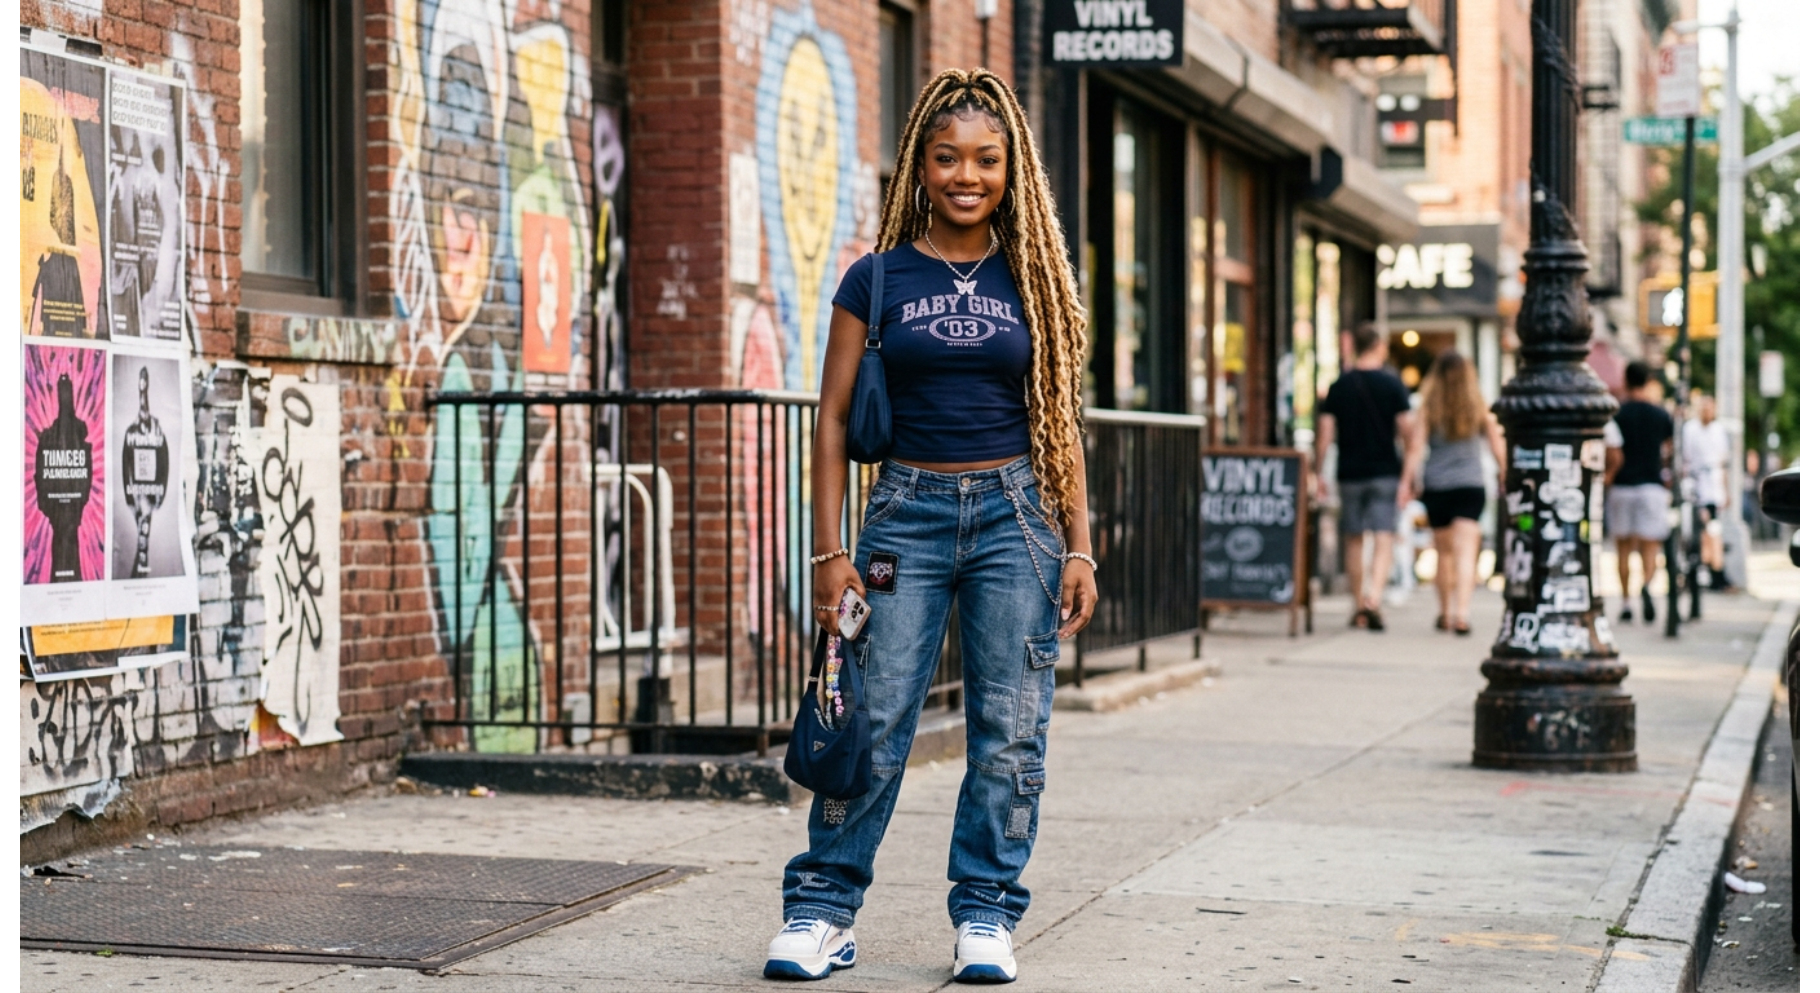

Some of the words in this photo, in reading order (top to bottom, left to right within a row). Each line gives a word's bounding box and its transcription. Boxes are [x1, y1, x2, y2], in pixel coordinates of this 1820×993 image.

[1074, 0, 1153, 28] VINYL
[1053, 29, 1174, 61] RECORDS
[901, 294, 961, 324] BABY
[967, 295, 1020, 325] GIRL
[944, 320, 978, 337] '03
[1201, 456, 1295, 495] VINYL
[1200, 492, 1296, 527] RECORDS
